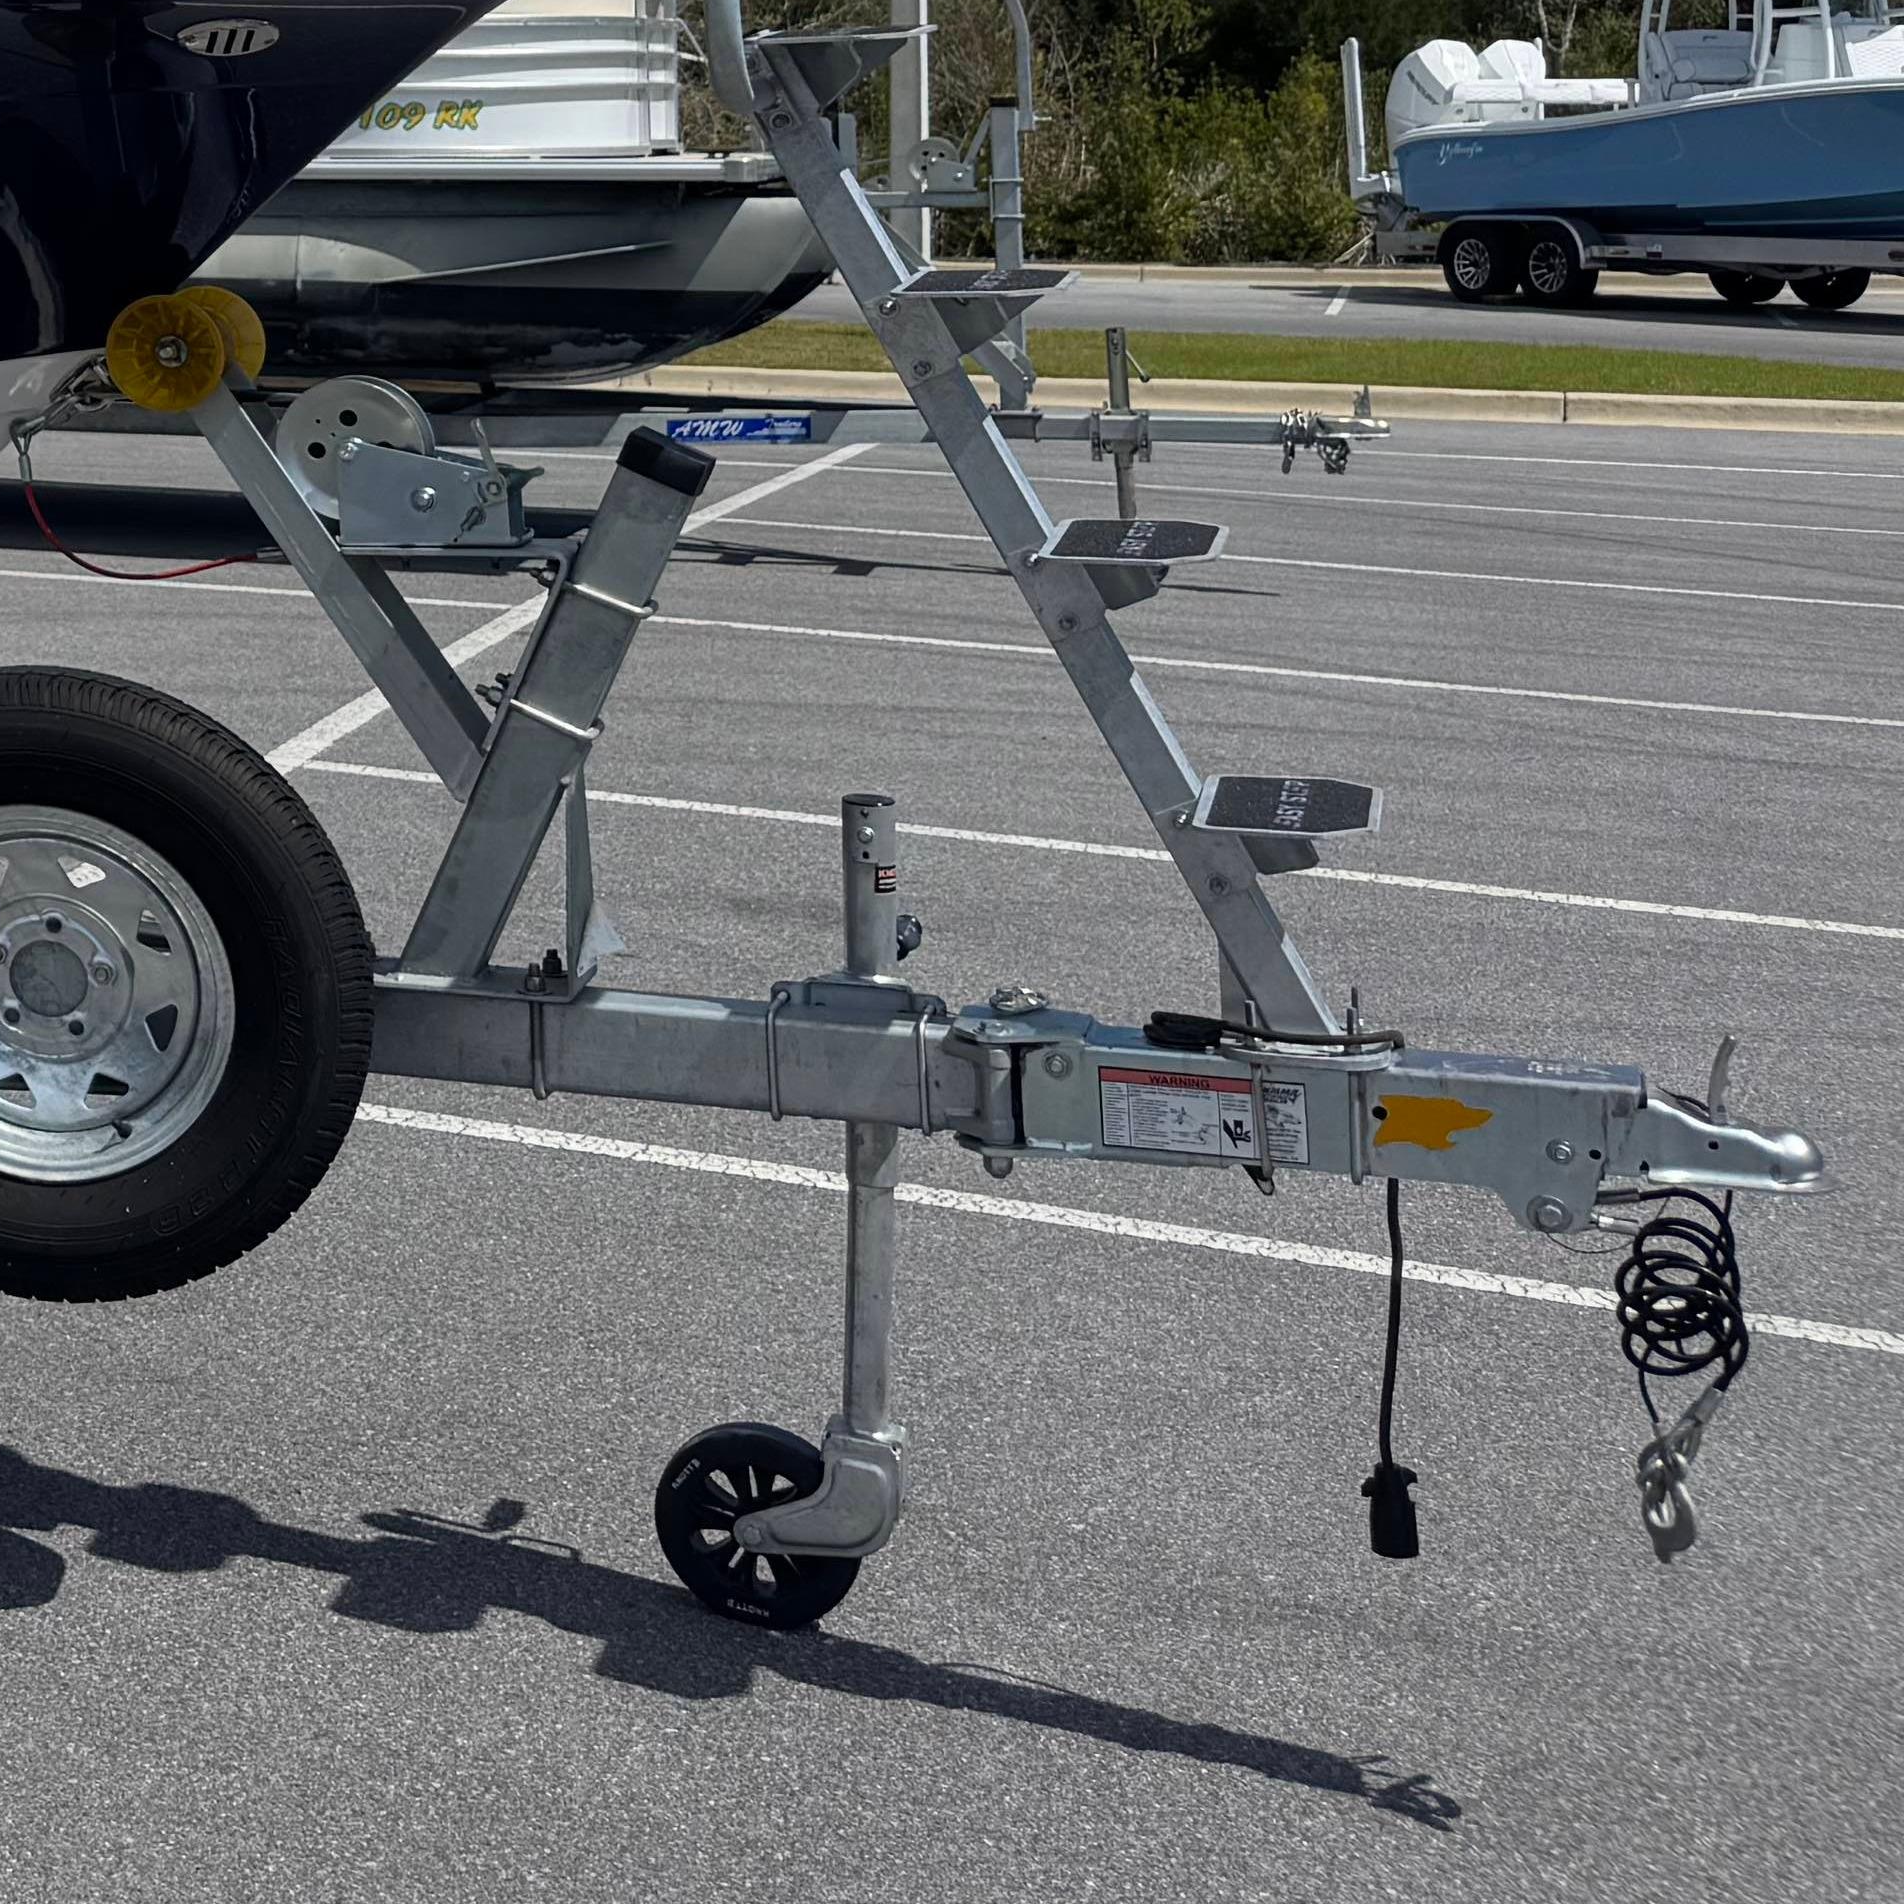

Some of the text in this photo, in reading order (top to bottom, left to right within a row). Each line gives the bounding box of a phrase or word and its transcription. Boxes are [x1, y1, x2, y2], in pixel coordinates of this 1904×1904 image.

[433, 98, 484, 131] RK
[672, 419, 745, 439] AMW
[1149, 1073, 1211, 1090] WARNING
